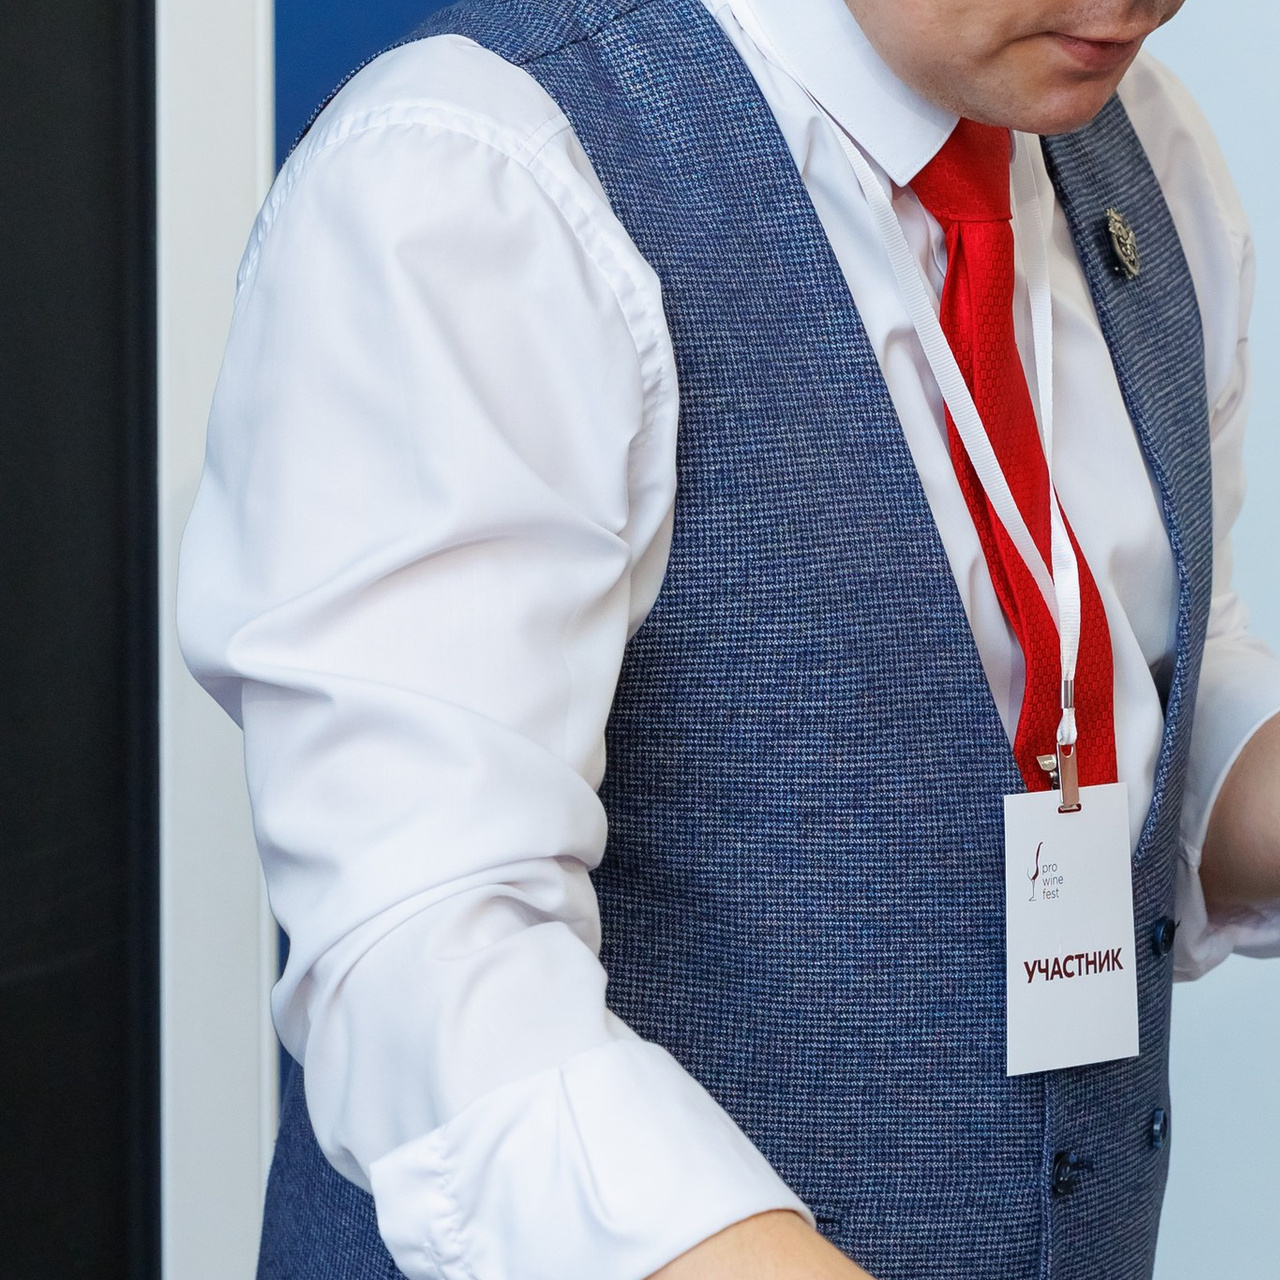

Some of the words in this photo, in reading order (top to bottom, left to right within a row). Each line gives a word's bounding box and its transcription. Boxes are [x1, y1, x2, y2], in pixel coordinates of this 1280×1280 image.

[1042, 862, 1058, 874] pro
[1042, 874, 1064, 886] wine
[1042, 888, 1060, 900] fest
[1023, 948, 1124, 984] УЧАСТНИК
